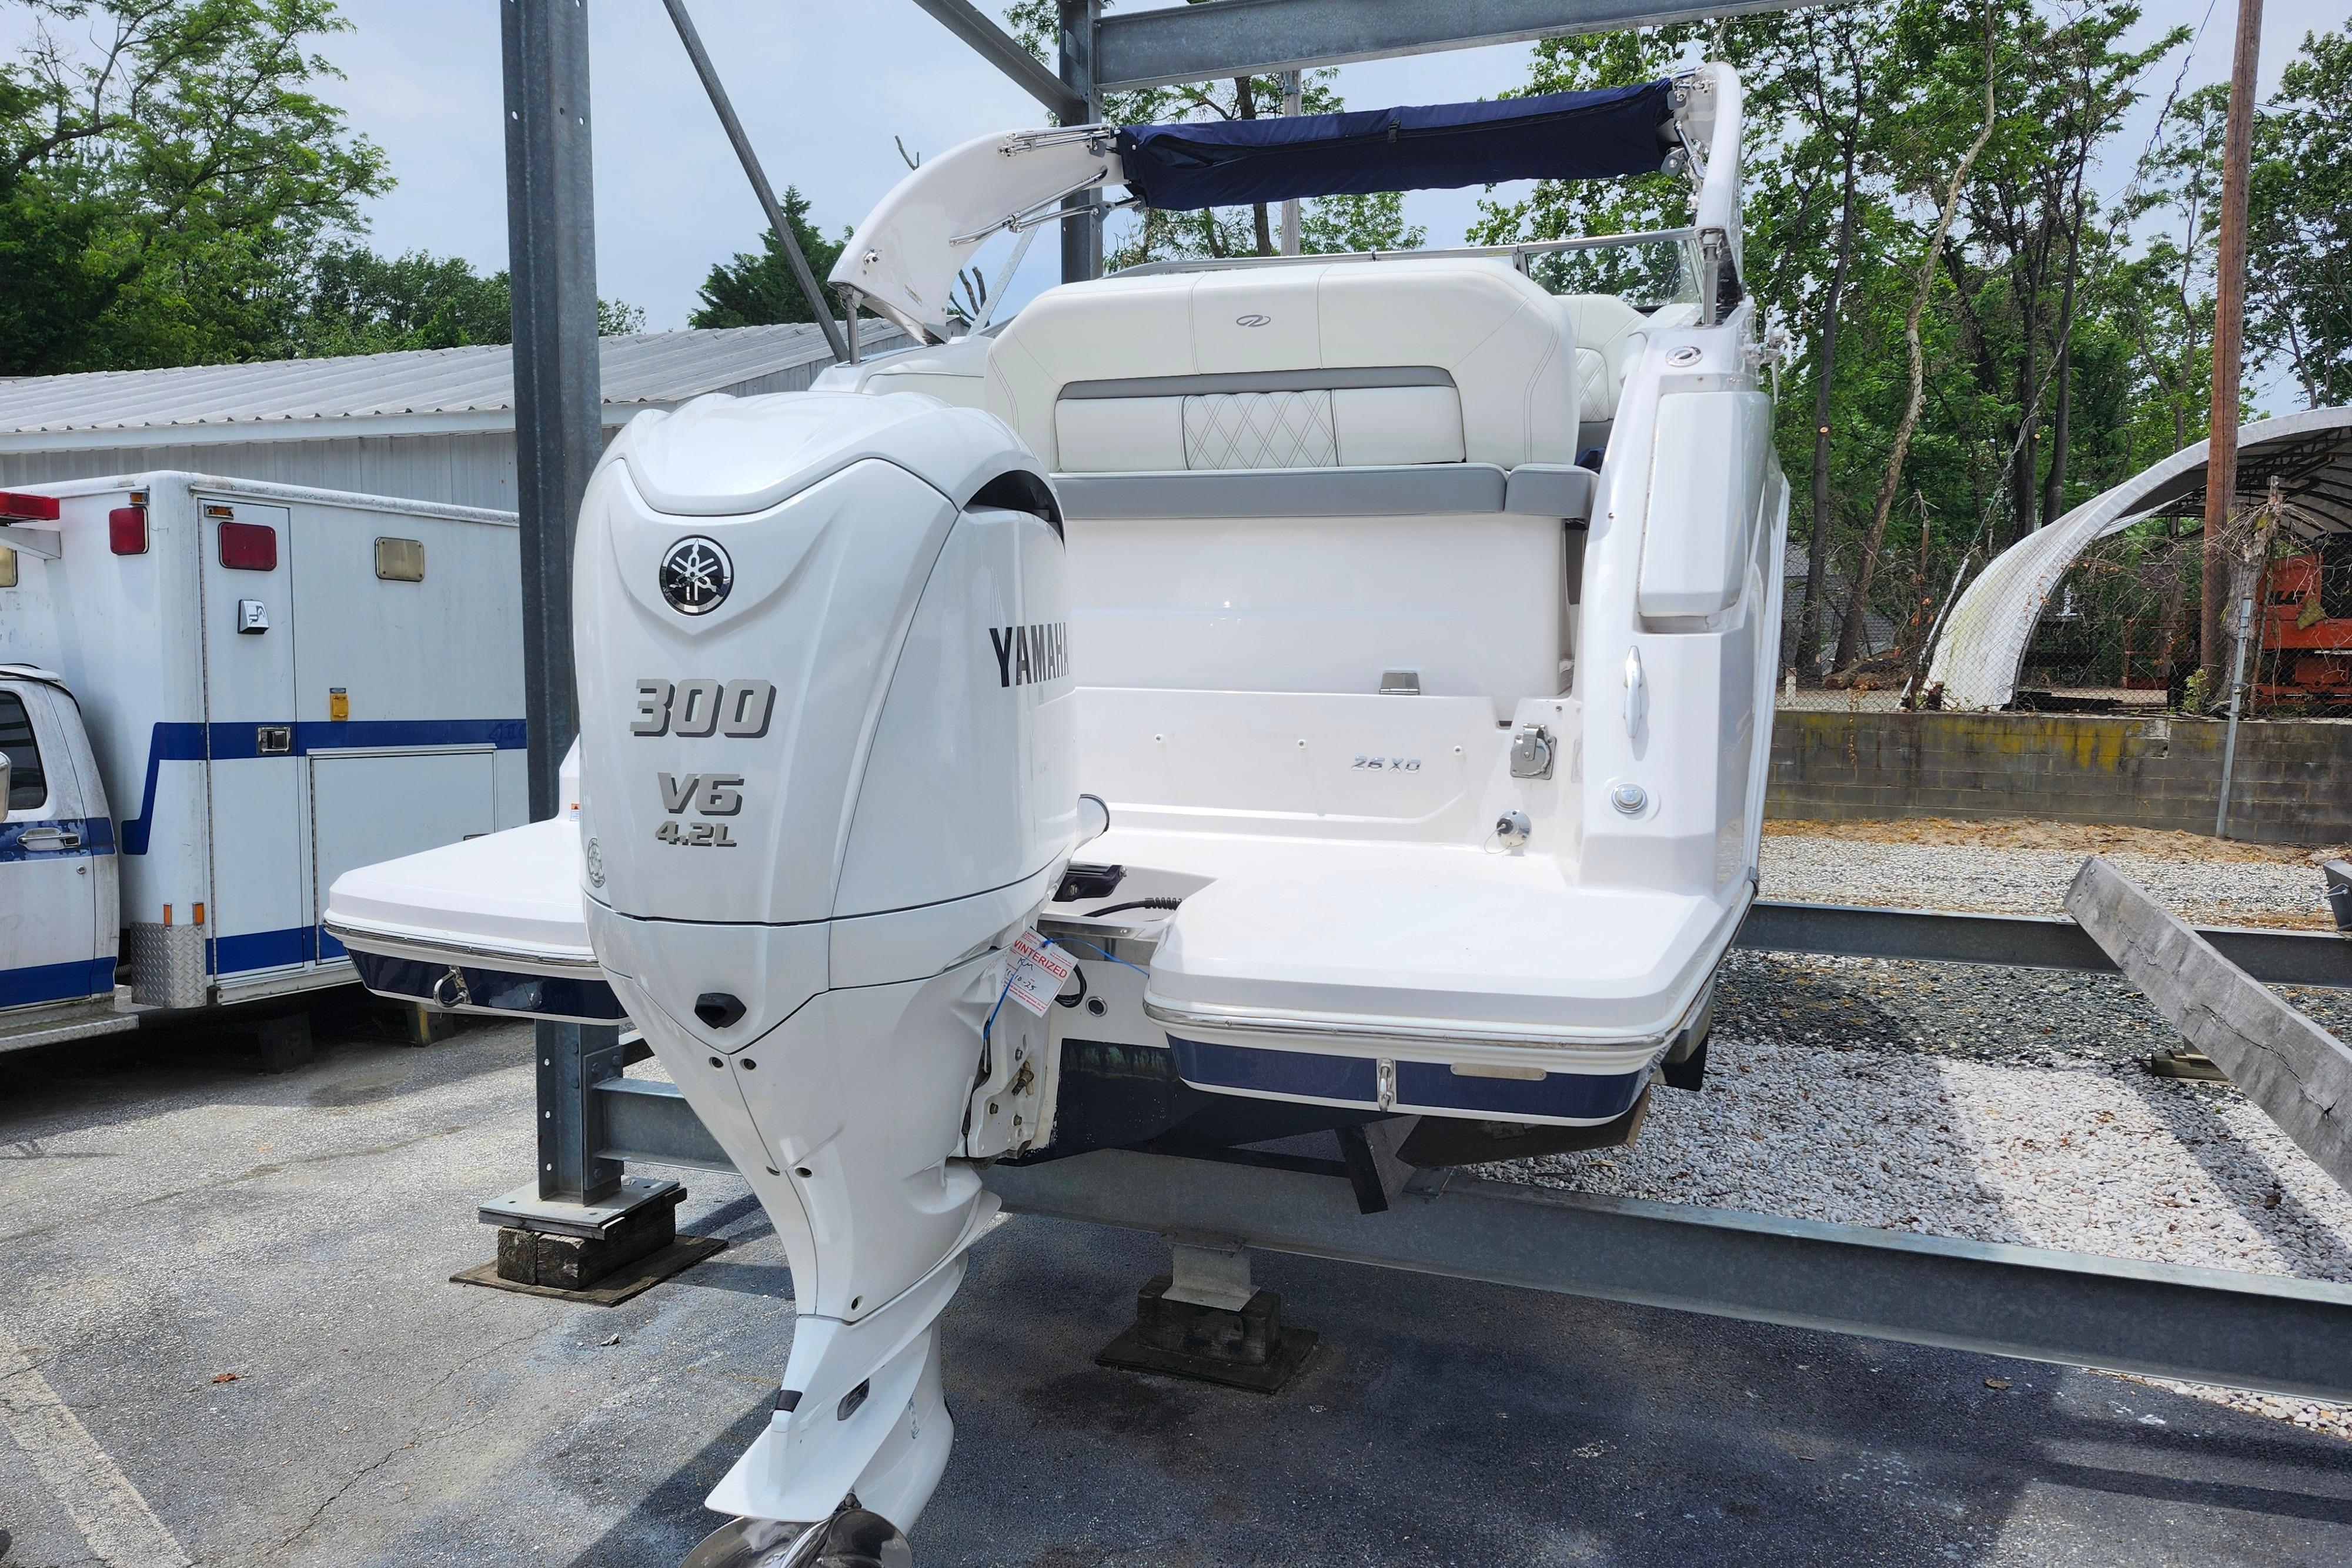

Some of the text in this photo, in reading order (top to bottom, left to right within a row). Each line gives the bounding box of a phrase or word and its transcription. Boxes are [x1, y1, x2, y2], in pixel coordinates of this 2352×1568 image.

[989, 622, 1069, 687] YAMAHA
[630, 678, 777, 738] 300
[1351, 755, 1385, 771] 26
[657, 772, 744, 815] V6
[655, 821, 737, 847] 4.2L
